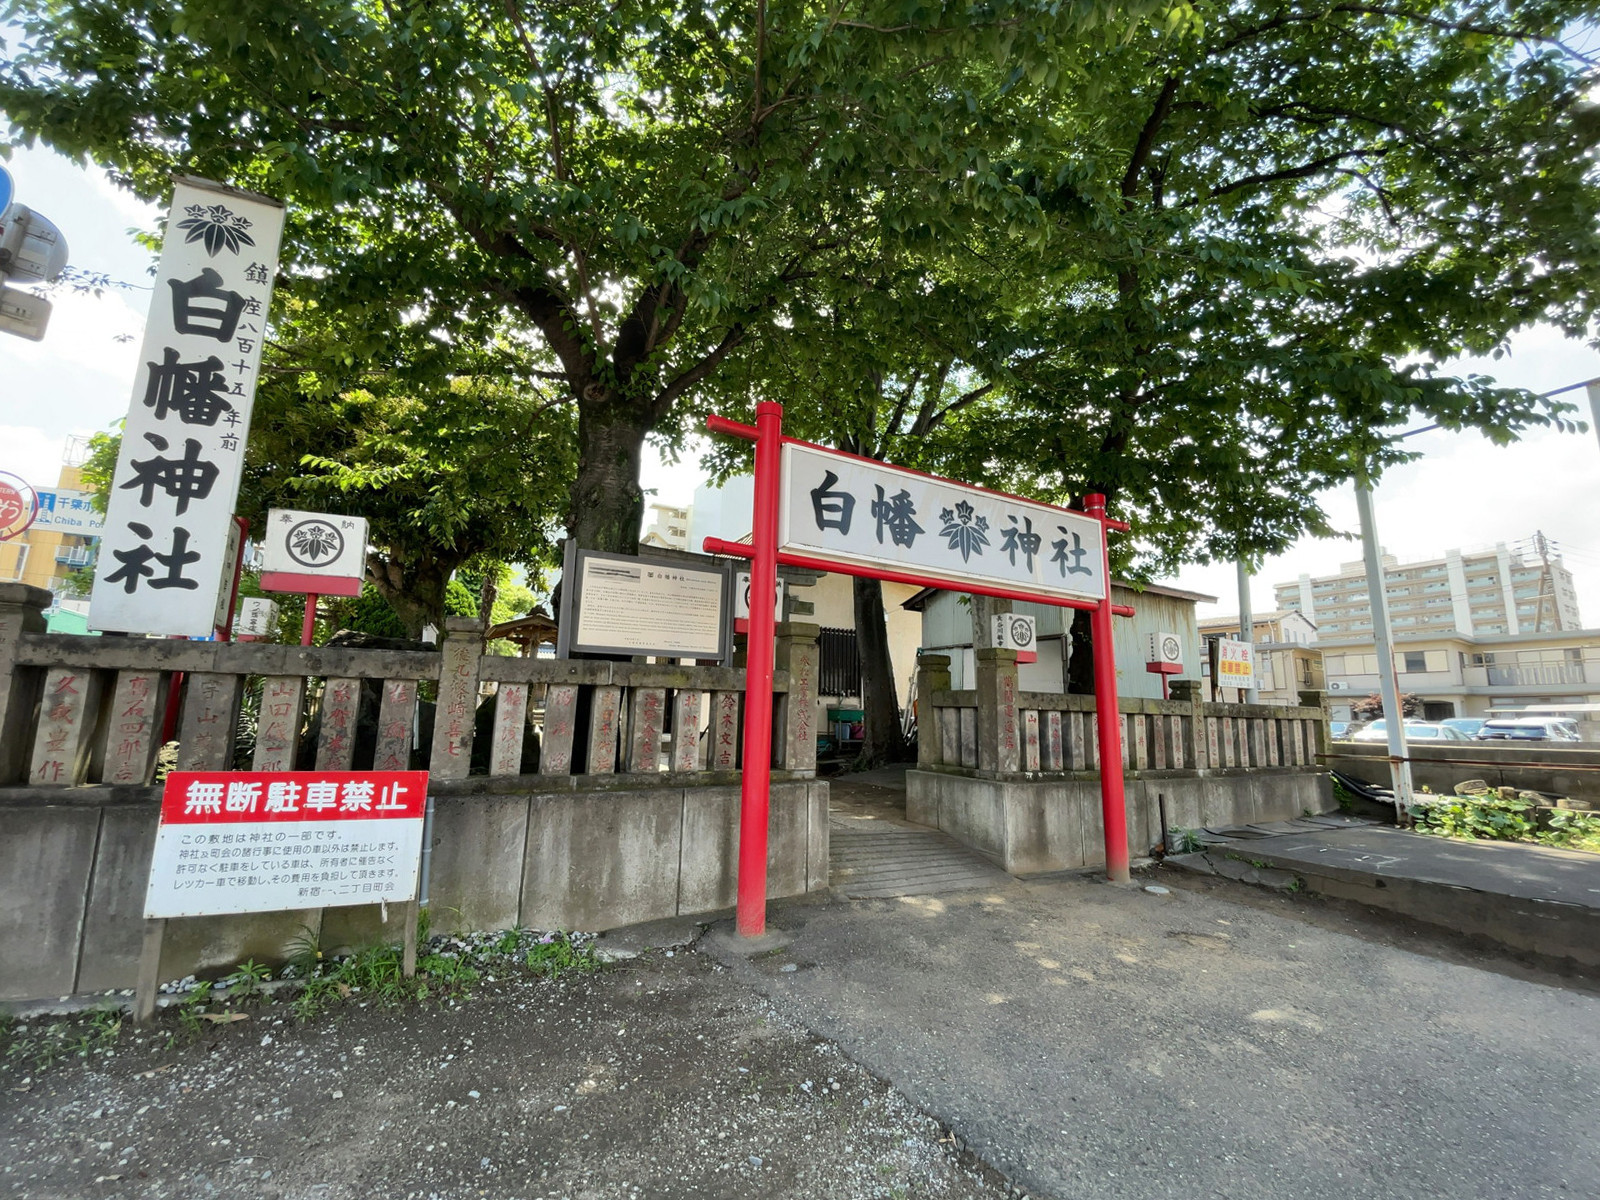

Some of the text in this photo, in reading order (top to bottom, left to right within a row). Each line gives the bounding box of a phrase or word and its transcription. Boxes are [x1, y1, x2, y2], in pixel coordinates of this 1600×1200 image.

[219, 261, 269, 451] 鎮座八百十五年前
[103, 267, 246, 594] 白幡神社
[54, 516, 82, 526] Chiba
[1222, 645, 1249, 661] 消火栓
[720, 693, 736, 765] 鈴木文吉
[184, 780, 408, 815] 無断駐車禁止
[181, 830, 342, 845] この敷地は神社の一部です。
